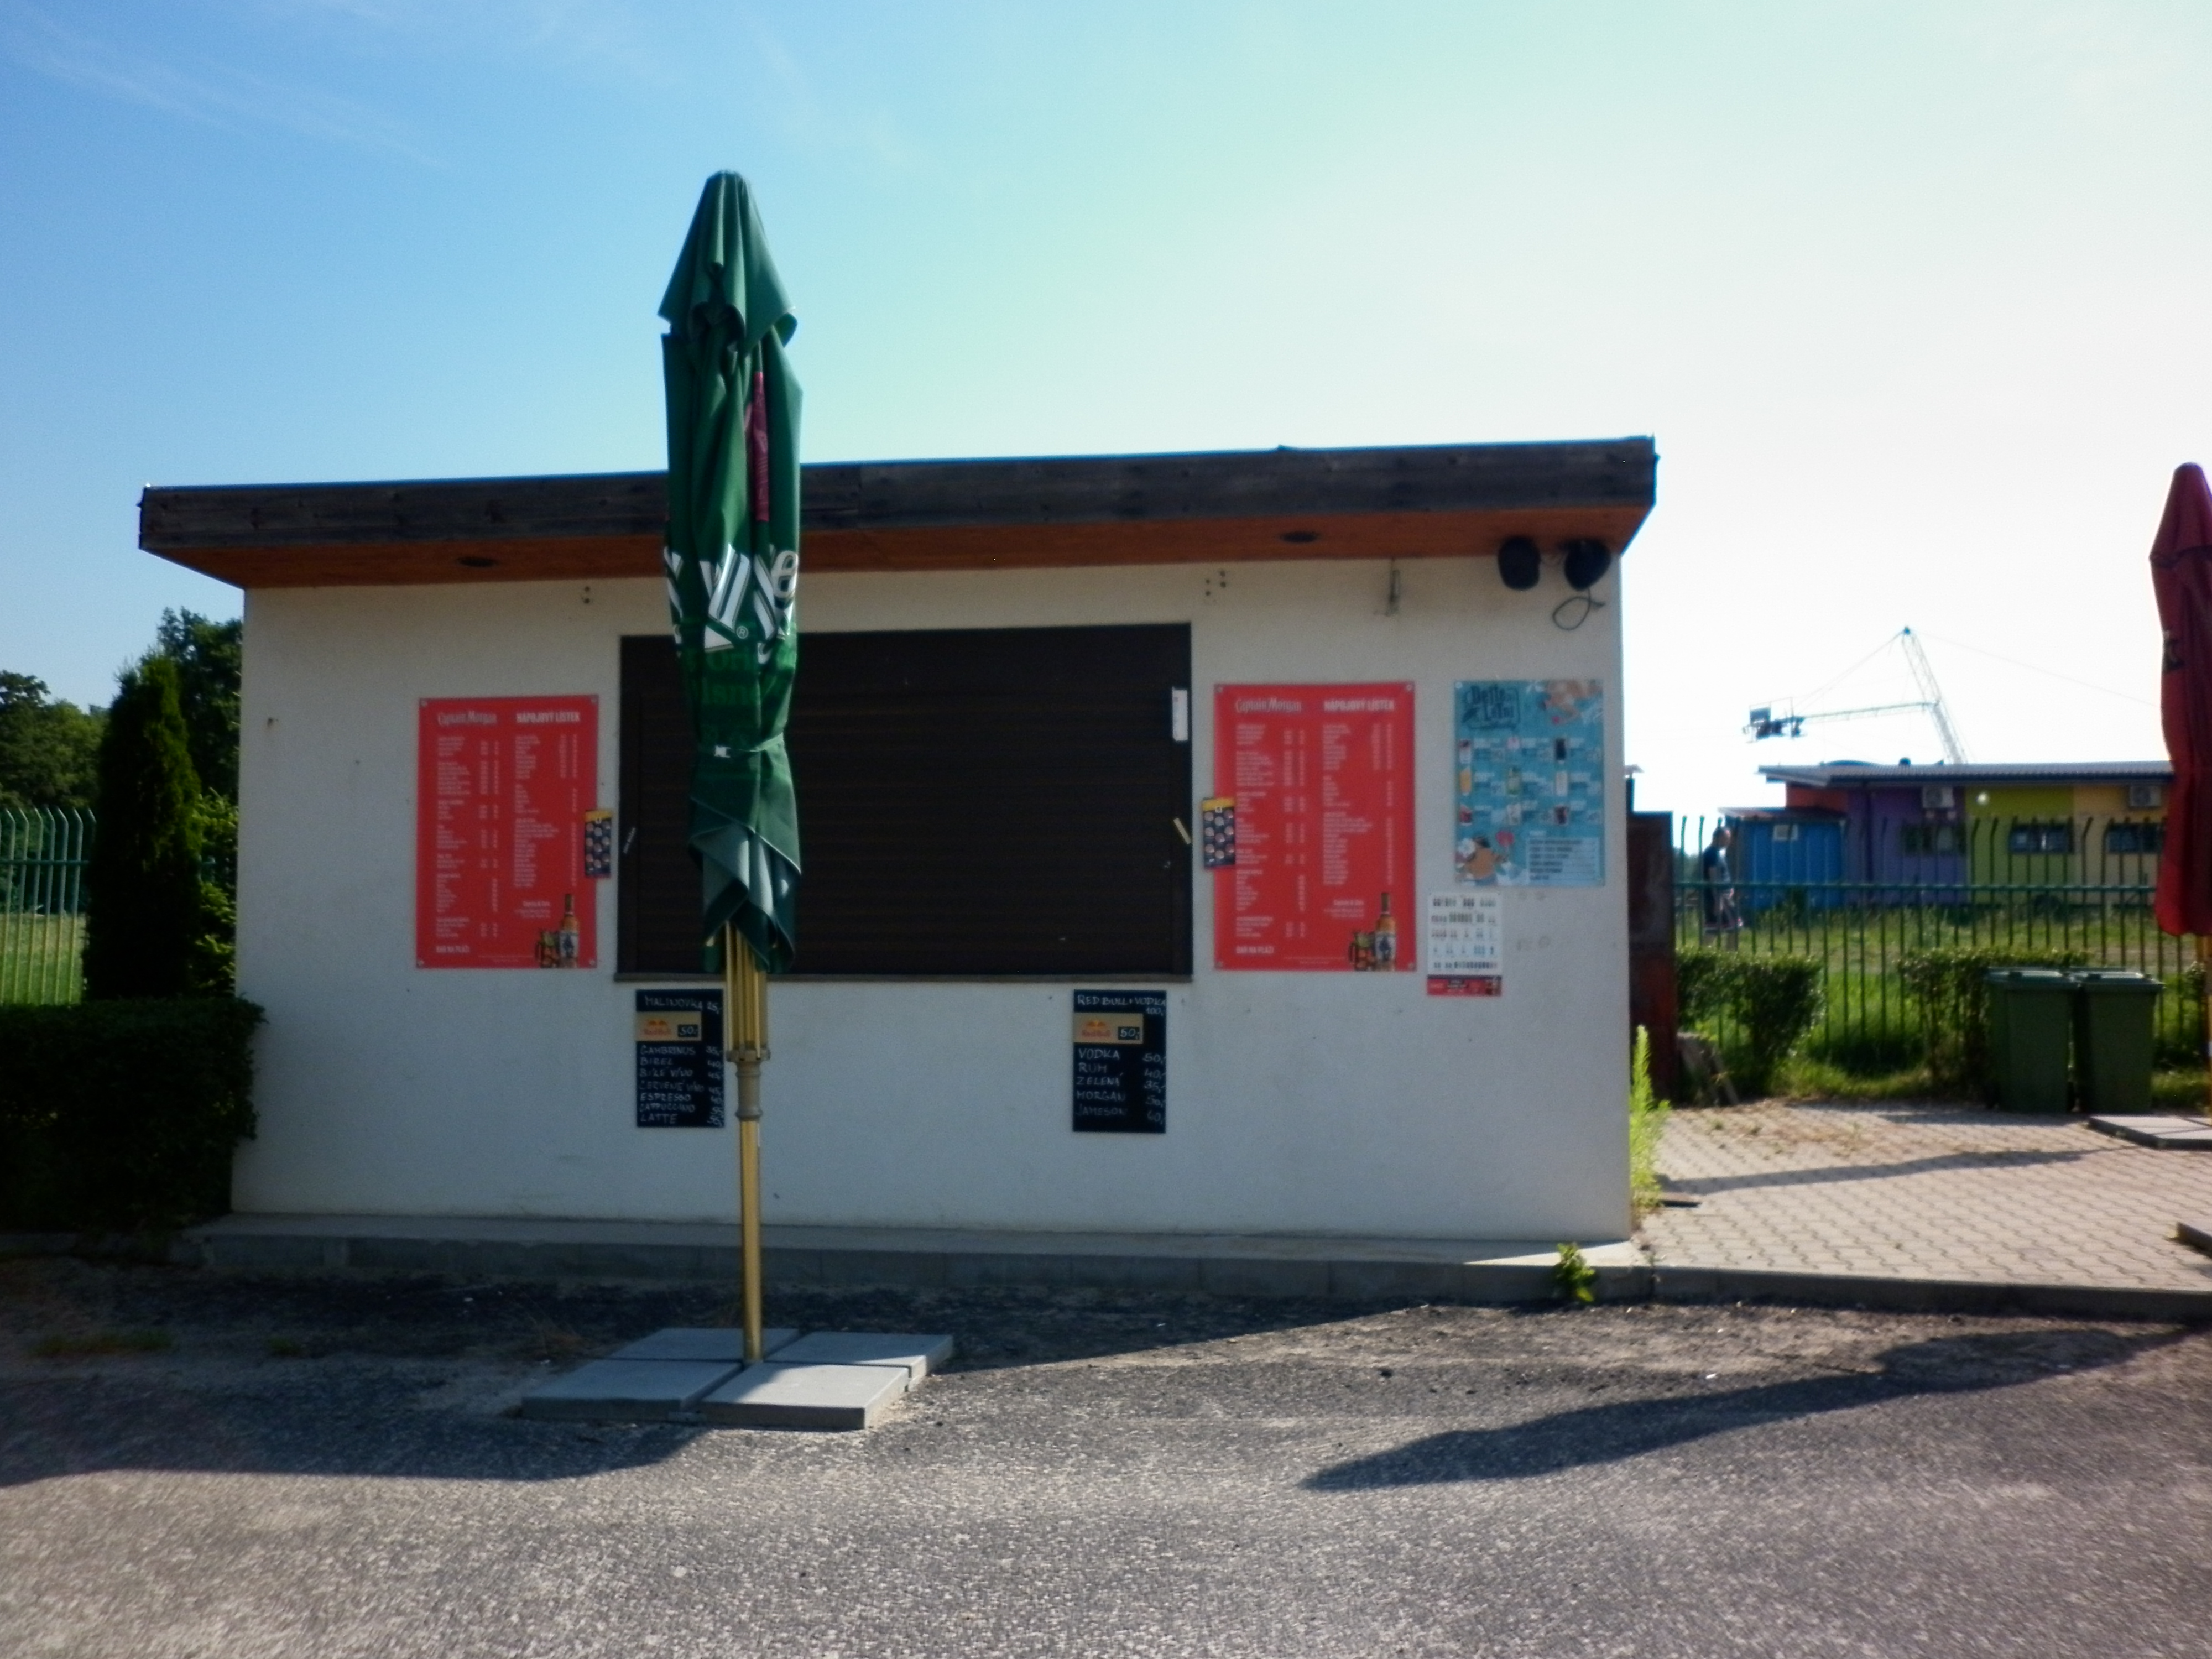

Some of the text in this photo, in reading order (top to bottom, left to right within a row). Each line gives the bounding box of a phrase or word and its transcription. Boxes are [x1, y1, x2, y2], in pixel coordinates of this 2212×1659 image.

[645, 995, 703, 1011] MALINOVKA
[1078, 994, 1100, 1005] RED
[1102, 997, 1128, 1006] BULL
[1135, 997, 1166, 1007] VODKA
[640, 1045, 696, 1055] GAMBRINUS
[1078, 1048, 1120, 1060] VODKA
[640, 1057, 673, 1066] BIREL
[1079, 1062, 1107, 1073] RUM
[640, 1093, 691, 1102] ESPRESSO
[1077, 1090, 1126, 1102] MORGAN
[1076, 1104, 1127, 1116] JAMESON
[640, 1113, 678, 1124] LATTE
